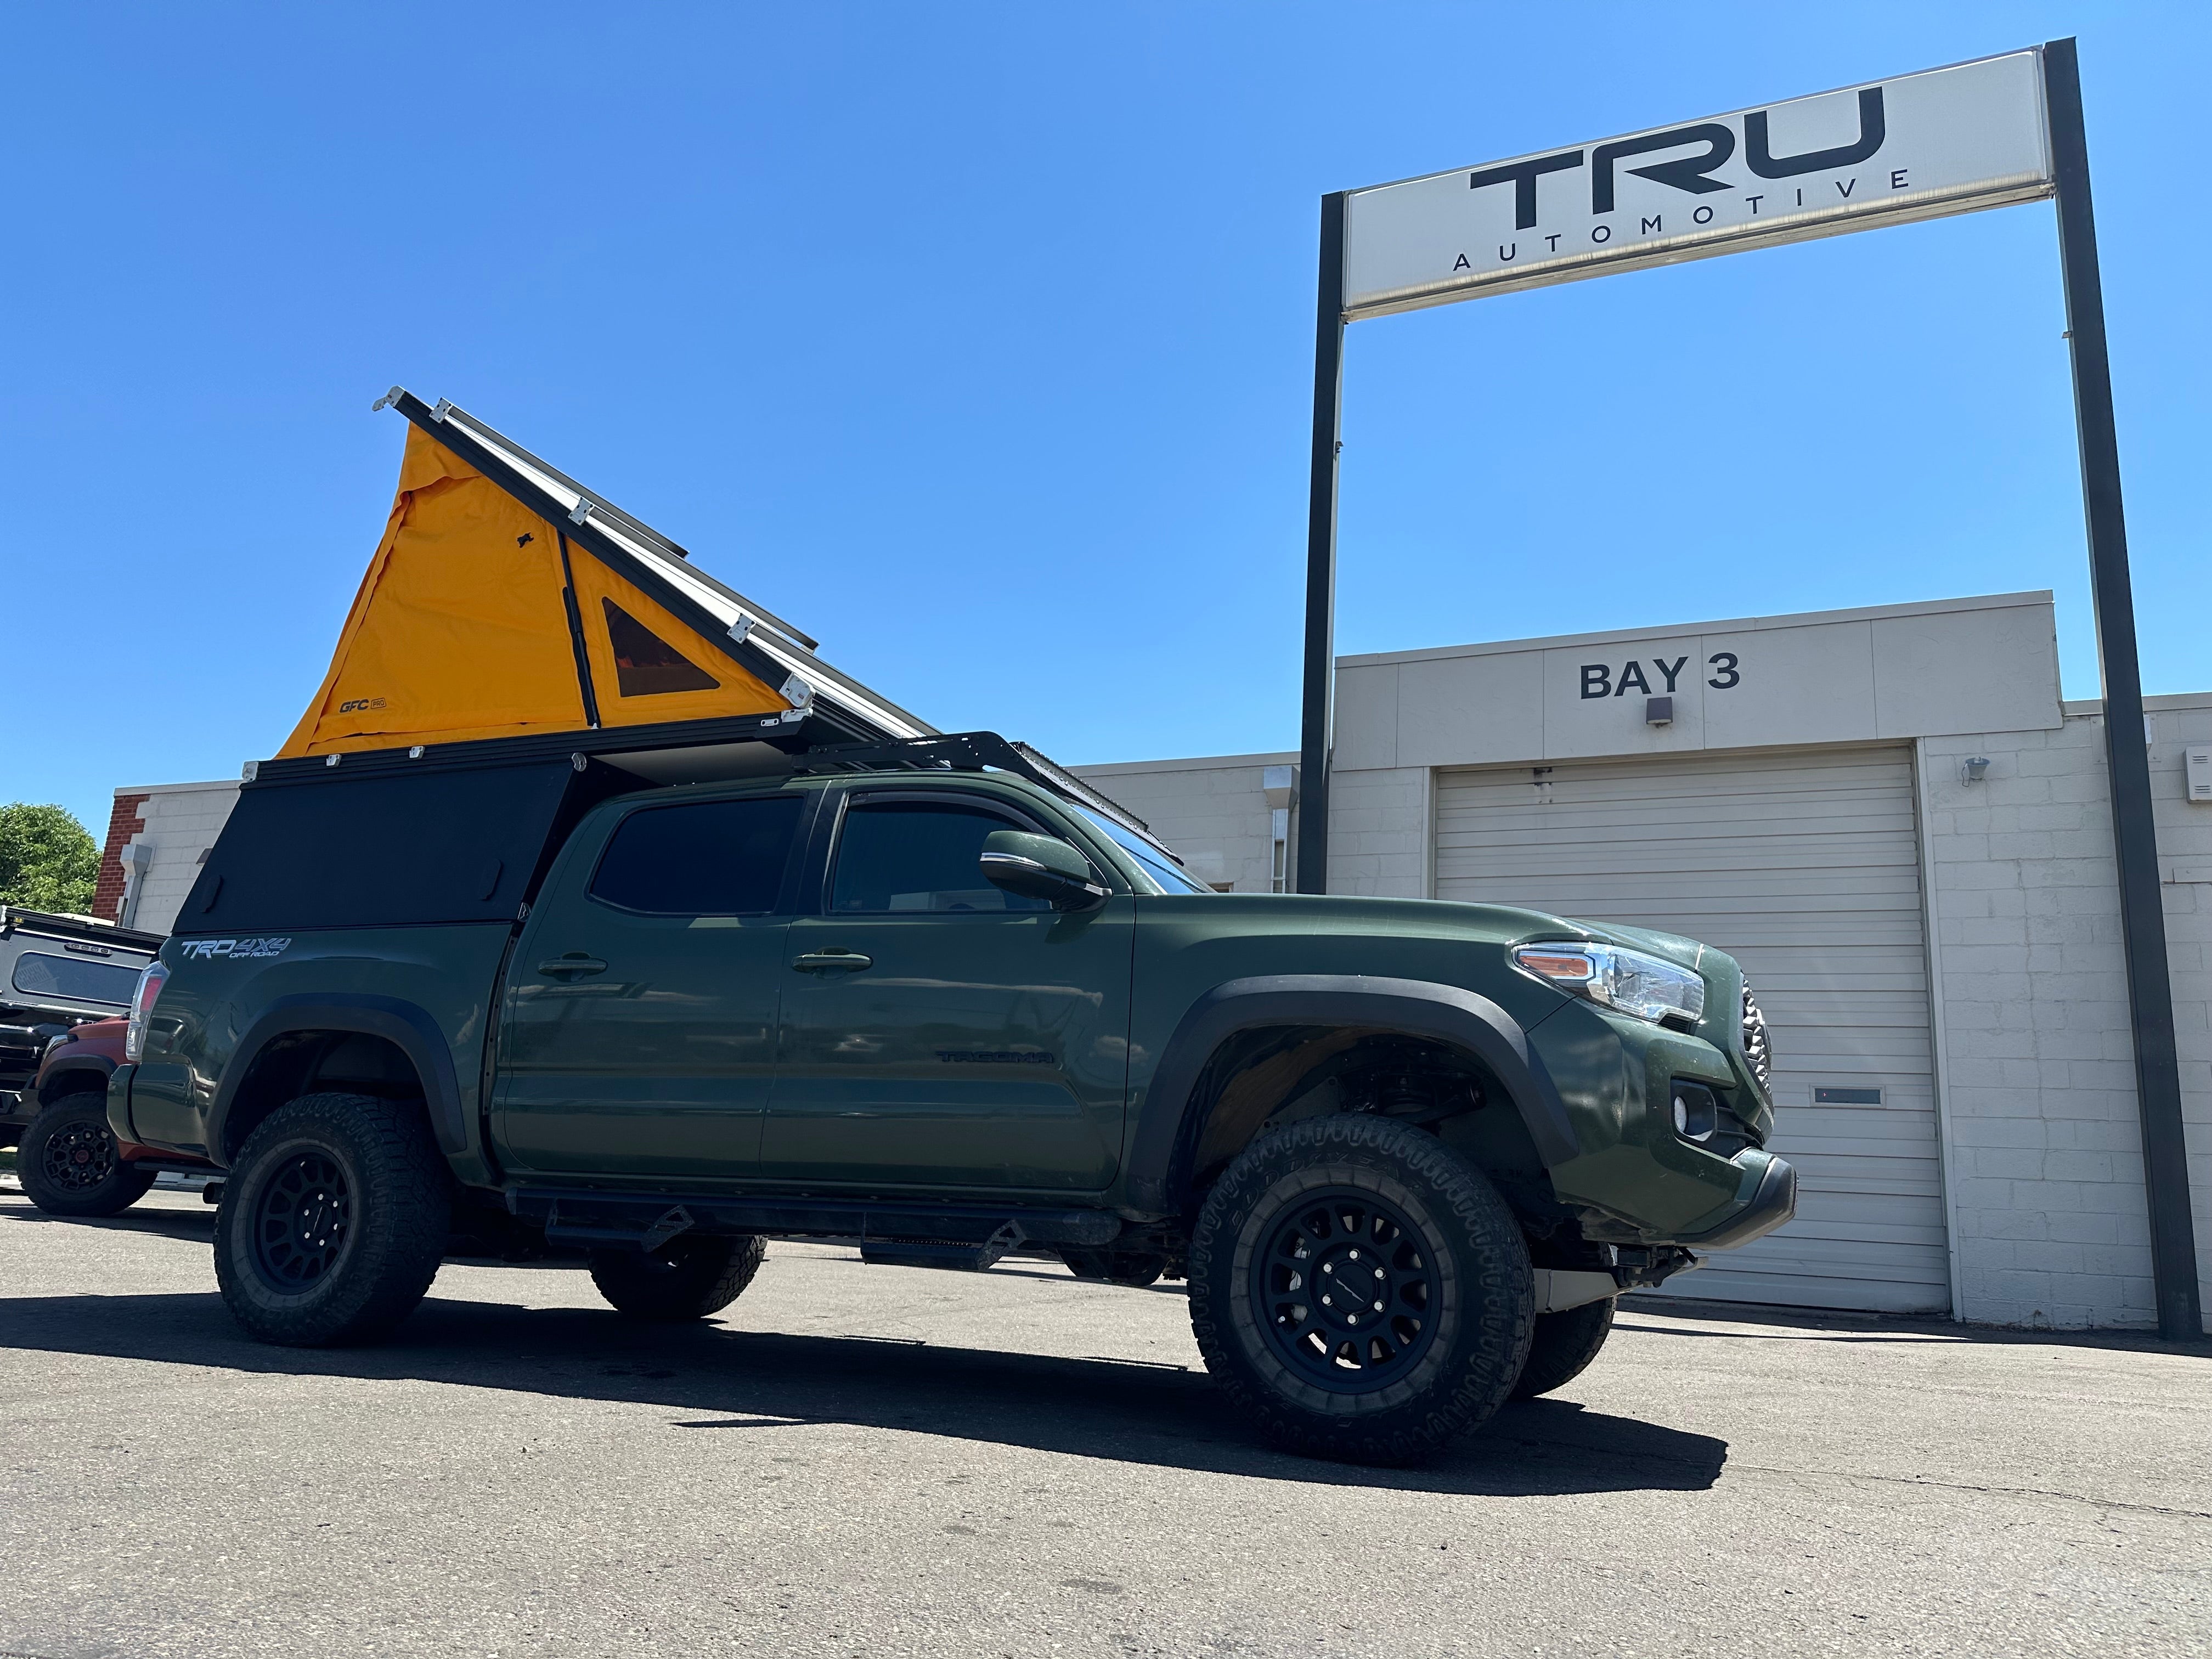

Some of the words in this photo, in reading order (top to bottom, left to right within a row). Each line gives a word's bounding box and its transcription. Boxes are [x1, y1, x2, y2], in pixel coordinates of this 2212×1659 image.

[1470, 86, 1886, 230] TRU
[1452, 168, 1909, 272] AUTOMOTIVE
[1581, 656, 1689, 699] BAY
[1708, 652, 1740, 689] 3
[339, 698, 370, 713] GFC
[373, 699, 385, 708] PRO
[180, 939, 236, 960] TRD
[935, 1050, 1054, 1063] TACOMA
